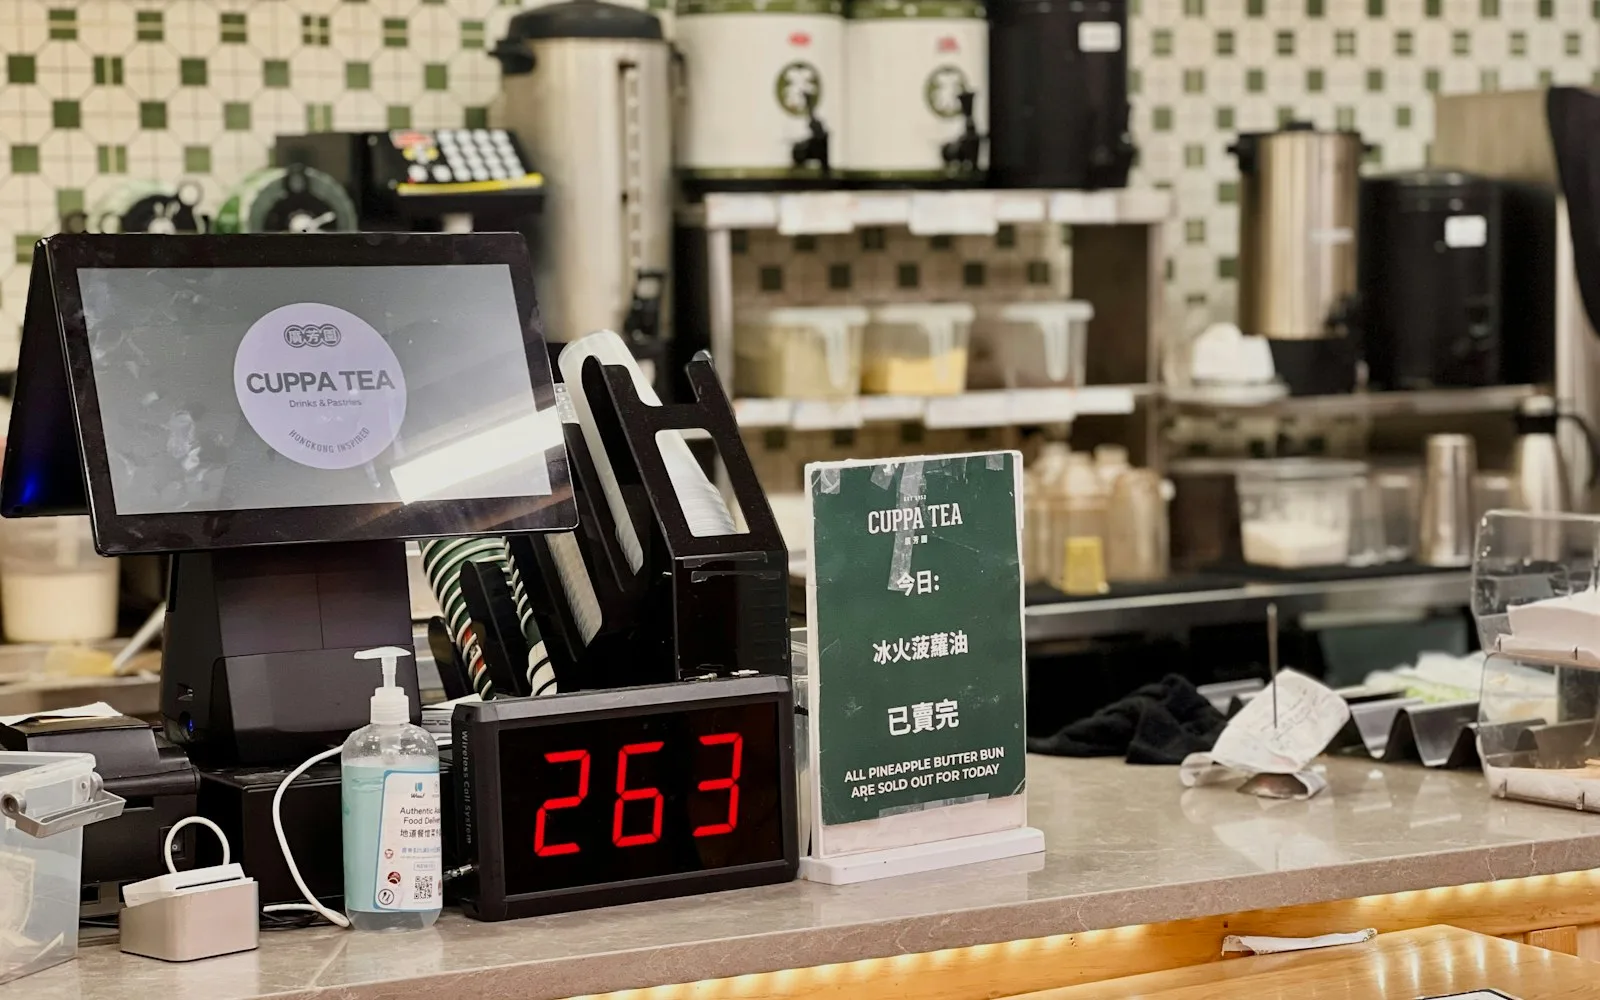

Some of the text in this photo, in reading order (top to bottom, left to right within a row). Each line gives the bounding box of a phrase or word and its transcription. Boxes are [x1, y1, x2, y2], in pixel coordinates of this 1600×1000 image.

[246, 370, 395, 394] CUPPA TEA
[289, 399, 318, 408] Drinks
[327, 398, 362, 407] Pastries
[337, 426, 370, 453] INSPIRED
[868, 503, 963, 534] CUPPA TEA
[873, 630, 969, 665] 冰火菠蘿油
[887, 699, 960, 736] 已賣完
[844, 747, 1005, 783] ALL PINEAPPLE BUTTER BUN
[851, 763, 1000, 799] ARE SOLD OUT FOR TODAY
[461, 730, 472, 845] Wireless Call System
[533, 732, 743, 857] 263
[399, 807, 433, 815] Authentic
[403, 817, 423, 825] Food
